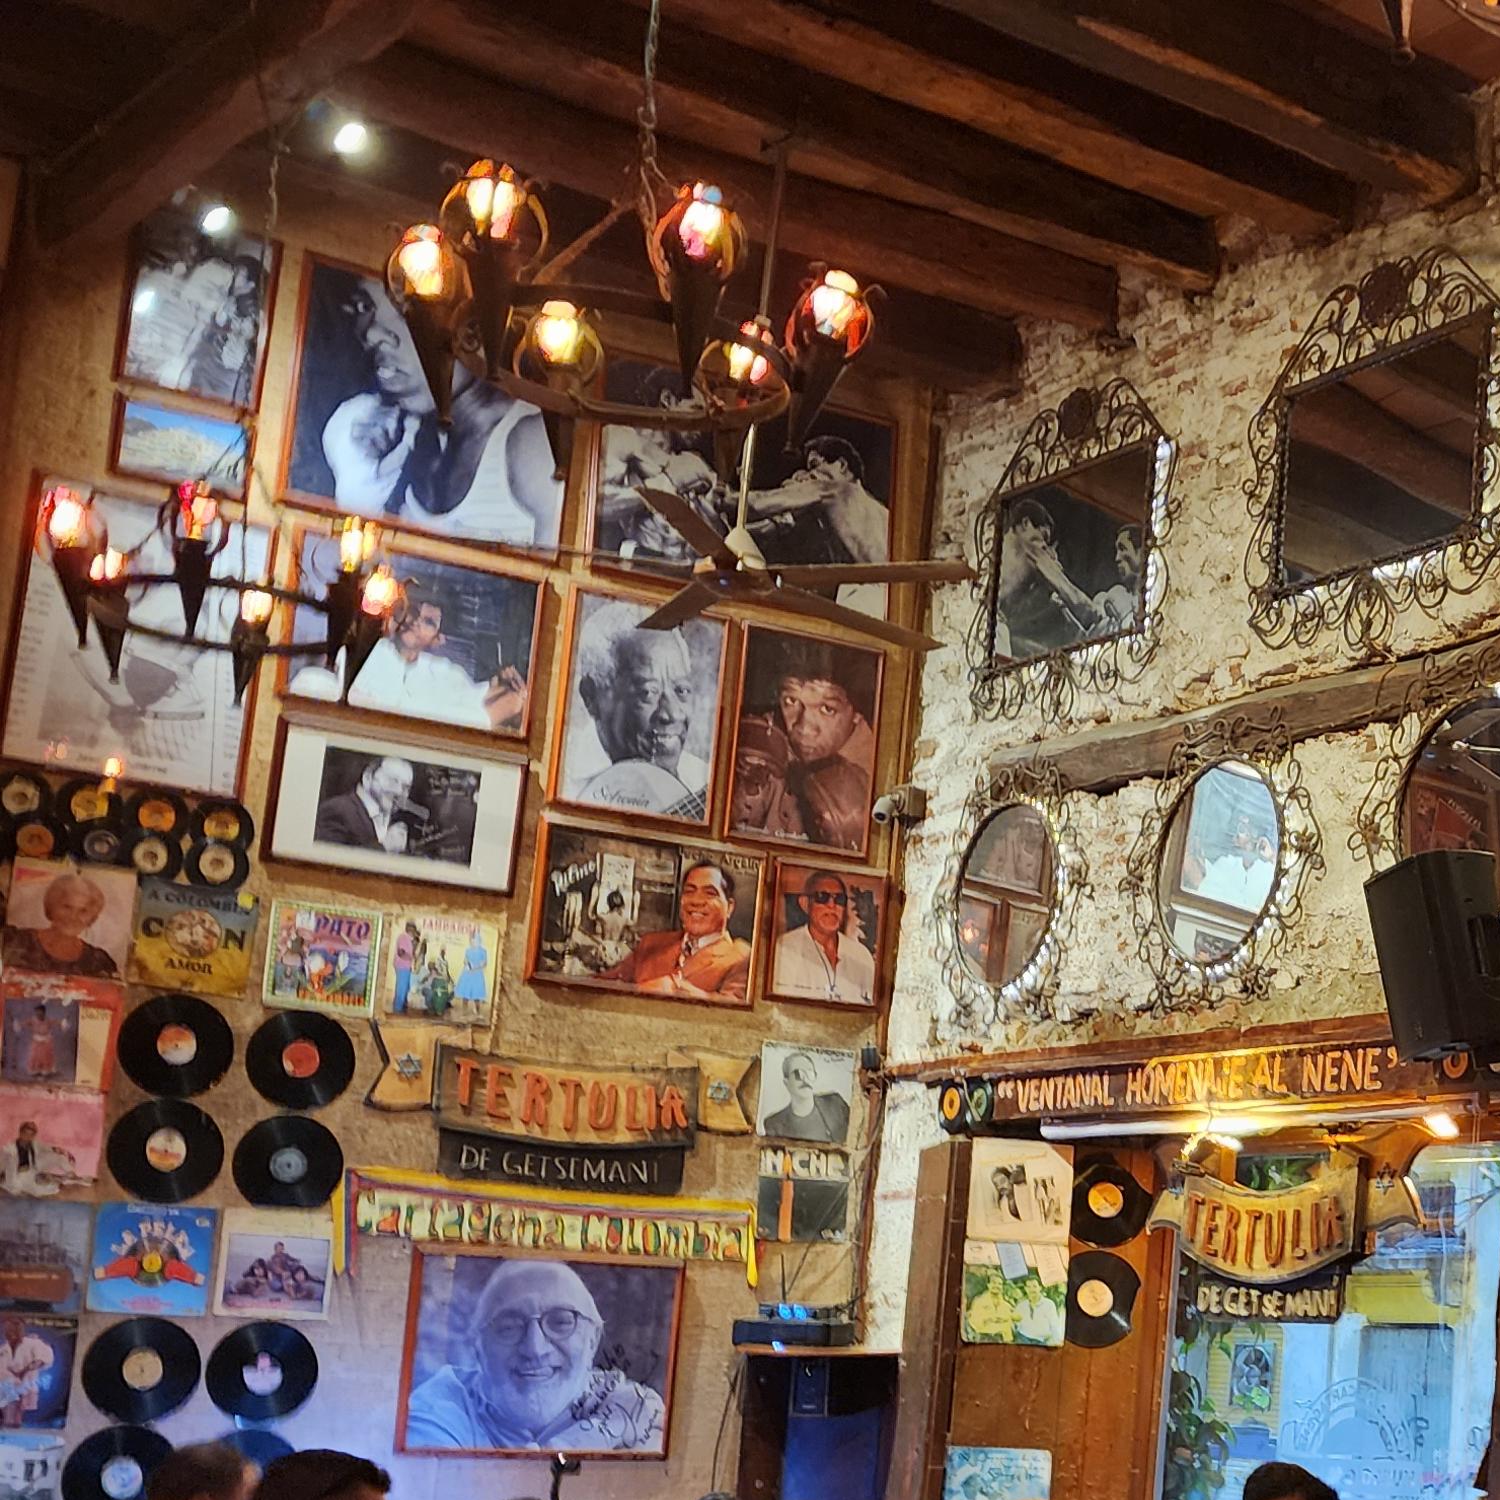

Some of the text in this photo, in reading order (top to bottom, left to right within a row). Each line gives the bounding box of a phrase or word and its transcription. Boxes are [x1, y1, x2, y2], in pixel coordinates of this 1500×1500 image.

[164, 958, 213, 975] AMOR
[1251, 1053, 1288, 1096] AL
[455, 1057, 689, 1131] TERTULIA
[460, 1145, 491, 1171] DE
[1187, 1190, 1346, 1269] TERTULIA
[1197, 1283, 1223, 1314] DE
